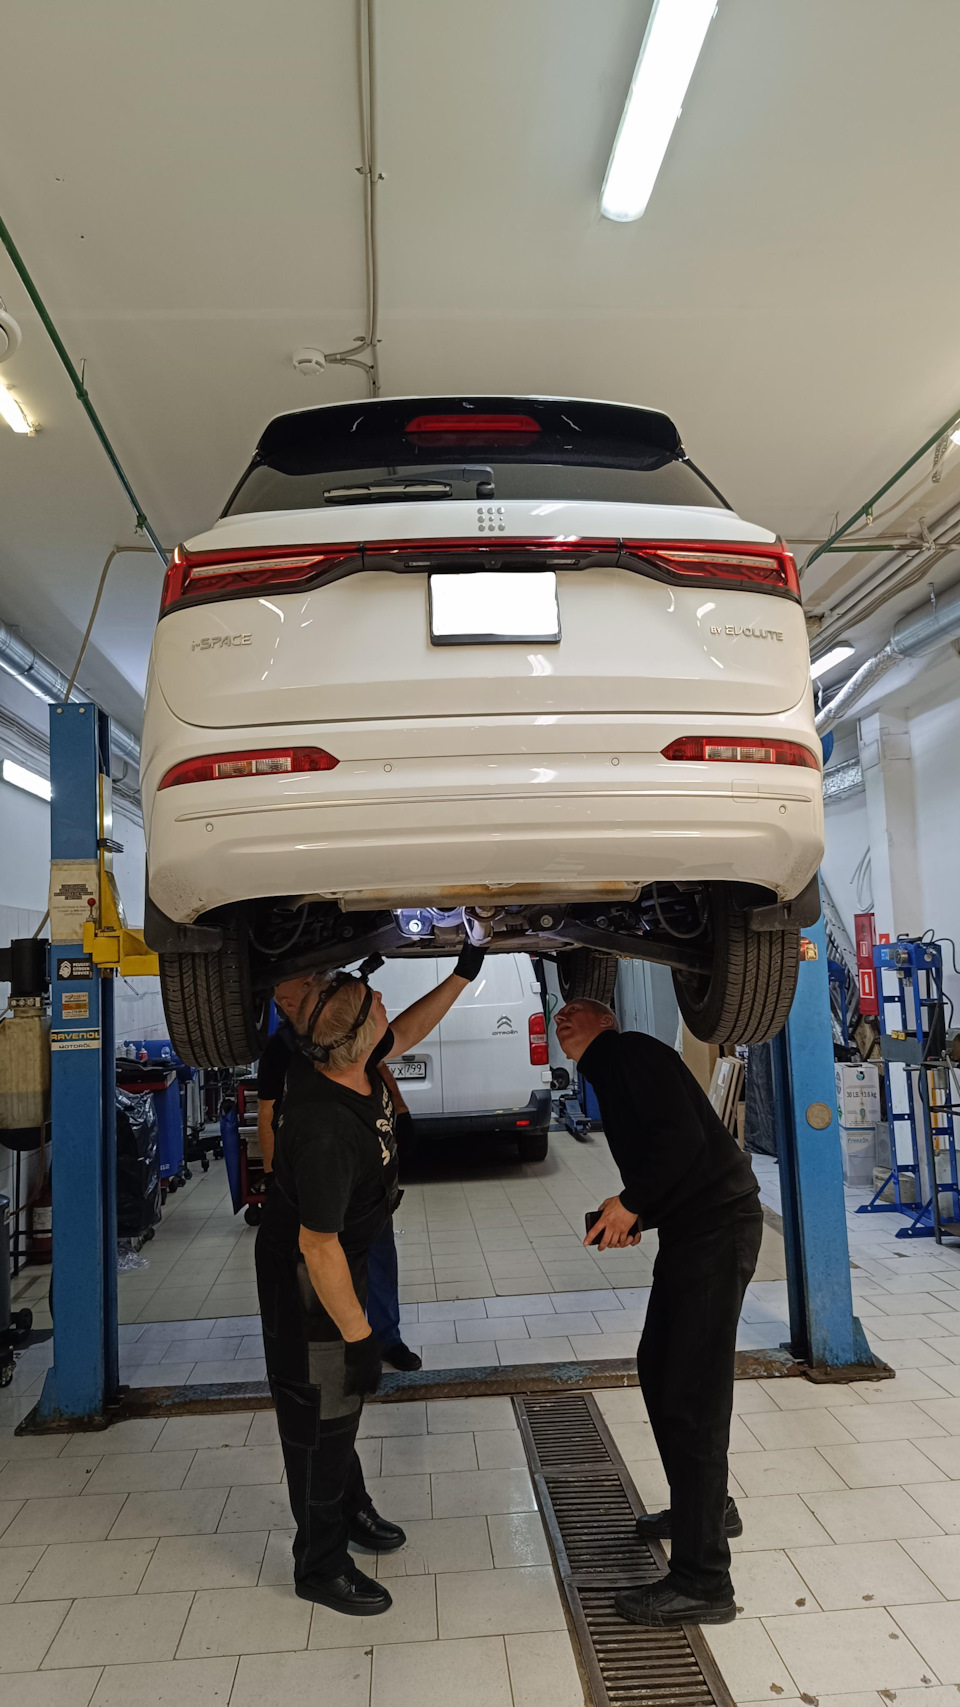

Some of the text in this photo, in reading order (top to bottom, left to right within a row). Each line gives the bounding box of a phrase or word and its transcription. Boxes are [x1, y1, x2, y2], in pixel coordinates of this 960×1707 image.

[710, 625, 784, 641] BY EVOLUTE
[191, 633, 252, 651] i-SPACE
[51, 1032, 100, 1040] RAVENOL
[58, 1042, 92, 1050] MOTORÖL
[406, 1064, 422, 1072] 799
